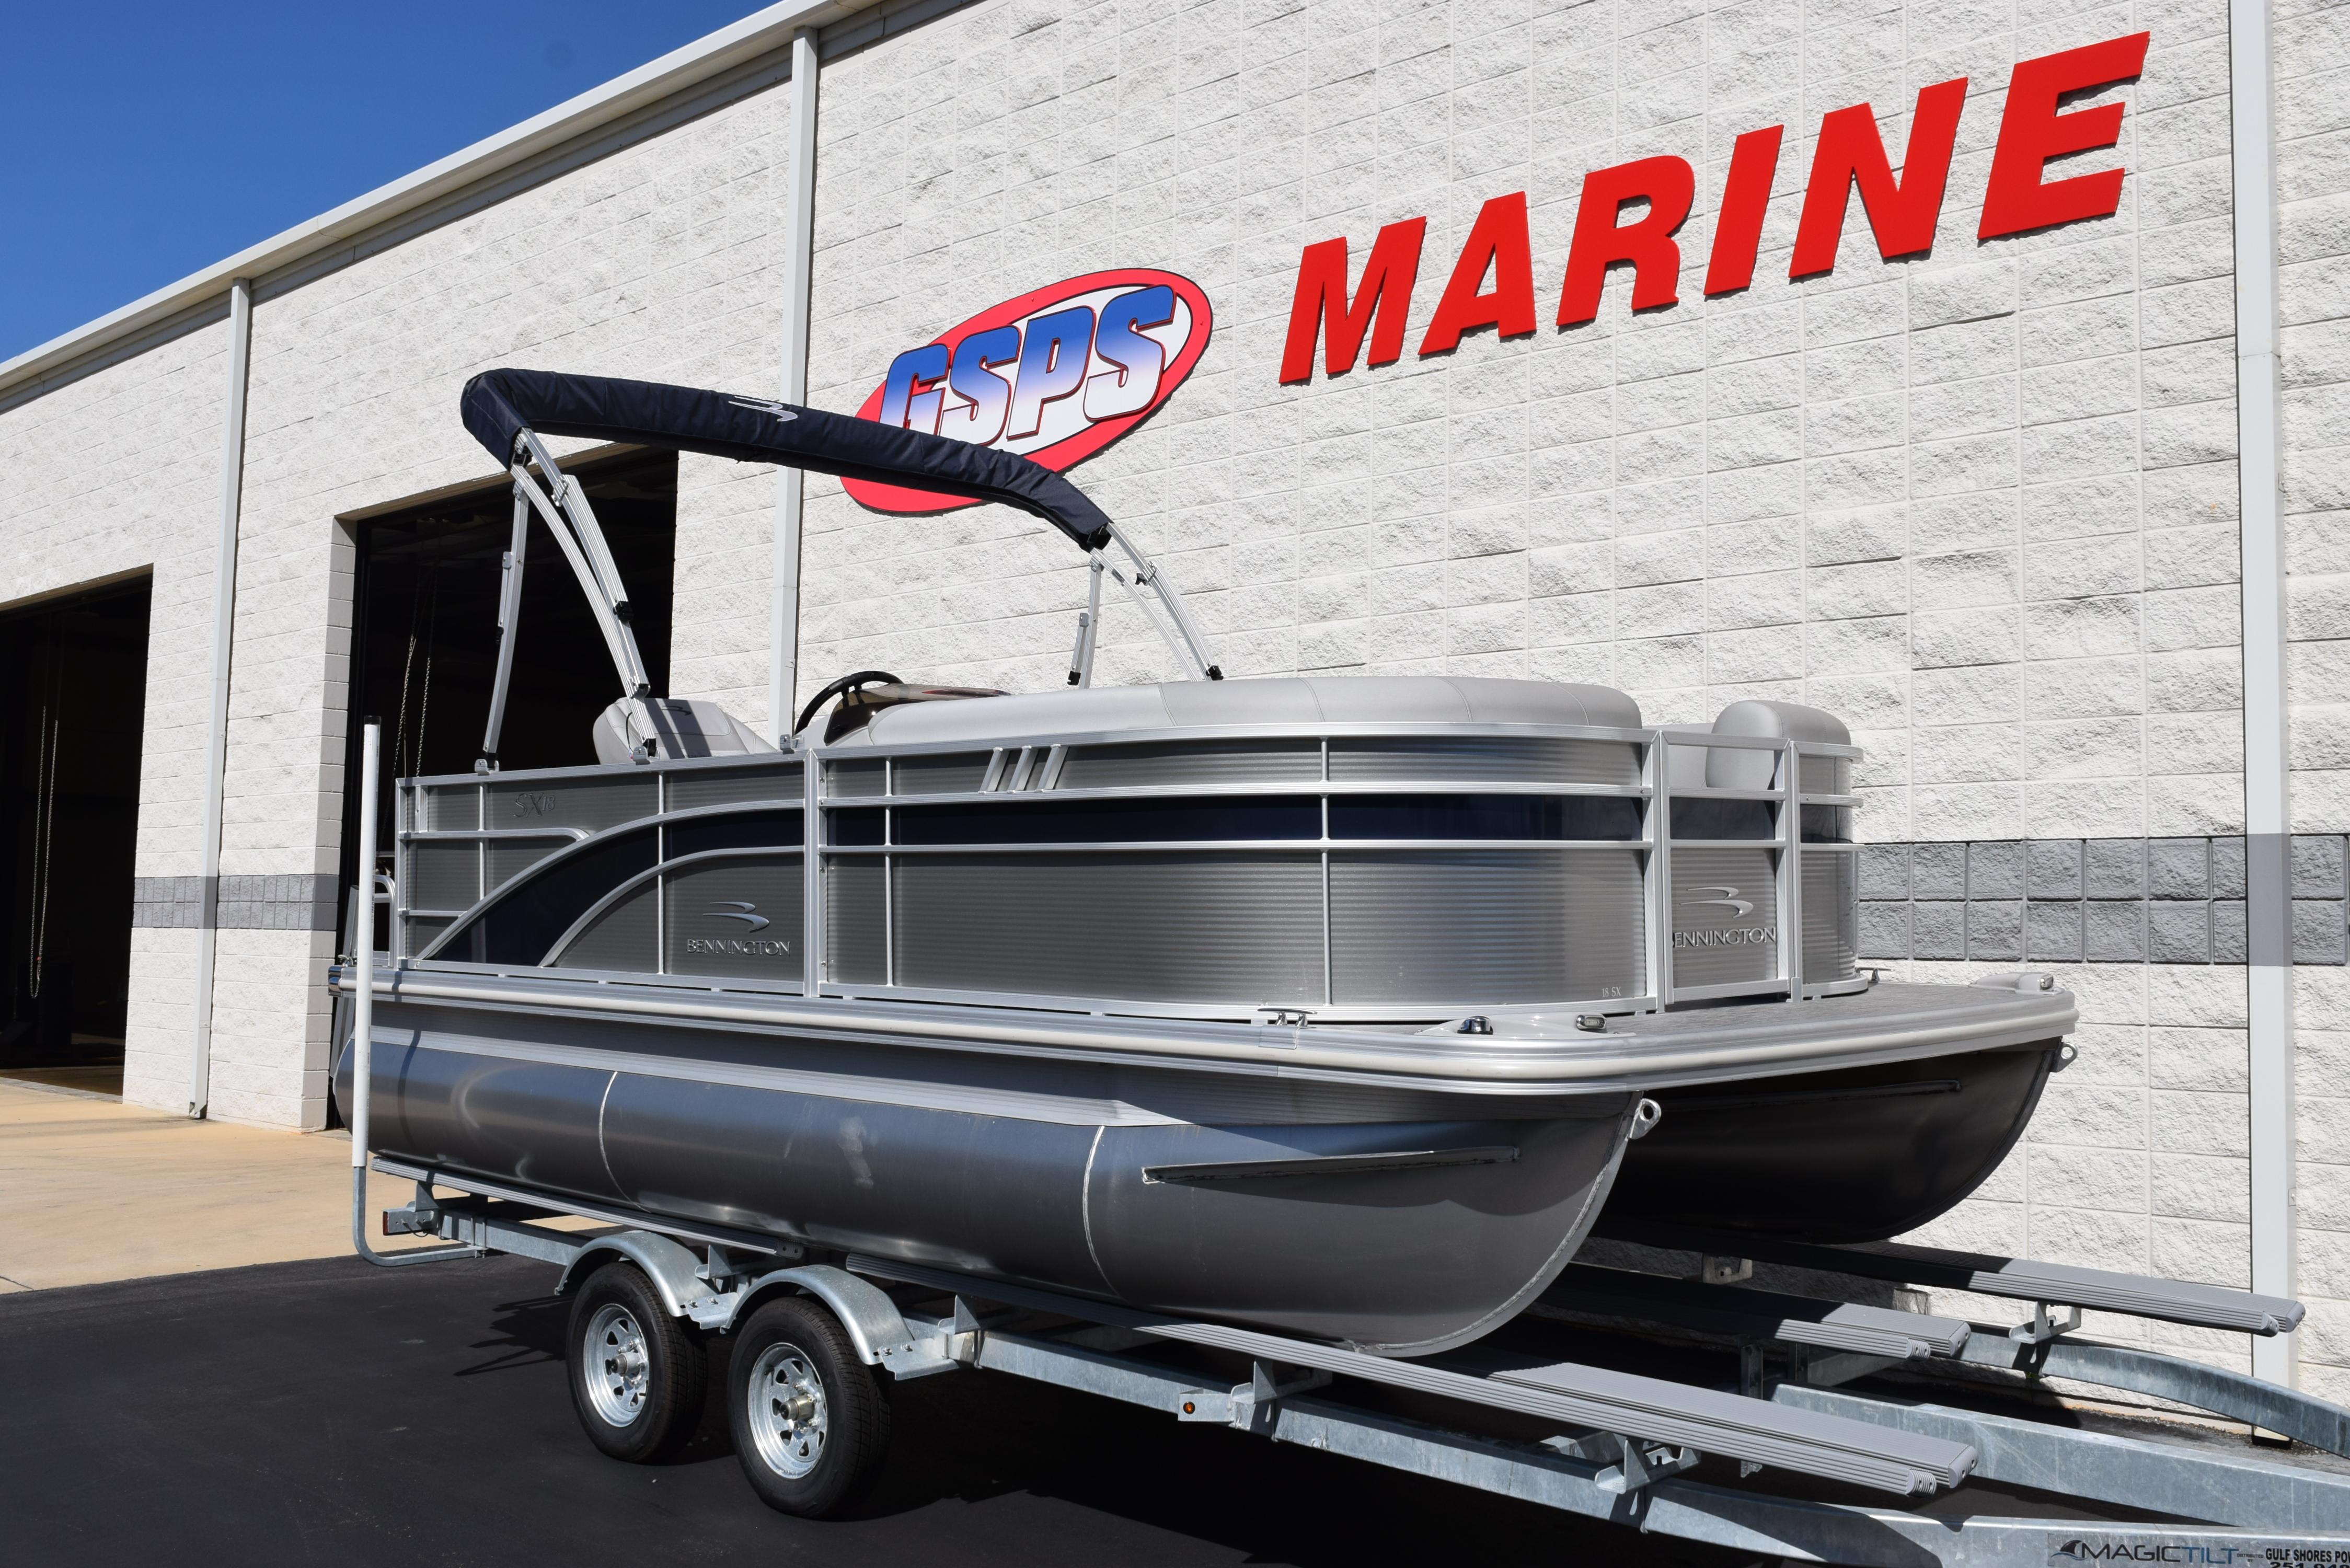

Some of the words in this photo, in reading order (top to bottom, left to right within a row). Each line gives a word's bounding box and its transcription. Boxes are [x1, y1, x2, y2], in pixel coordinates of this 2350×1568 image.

[1279, 31, 2150, 383] MARINE
[879, 284, 1177, 447] GSPS
[687, 939, 790, 955] BENNINGTON
[1673, 927, 1776, 948] ENNINGTON
[1602, 987, 1609, 998] 18
[1611, 986, 1621, 997] SX
[2081, 1542, 2239, 1564] MAGICTILT
[2265, 1548, 2290, 1561] GULF
[2293, 1549, 2332, 1563] SHORES
[2335, 1551, 2350, 1563] PO
